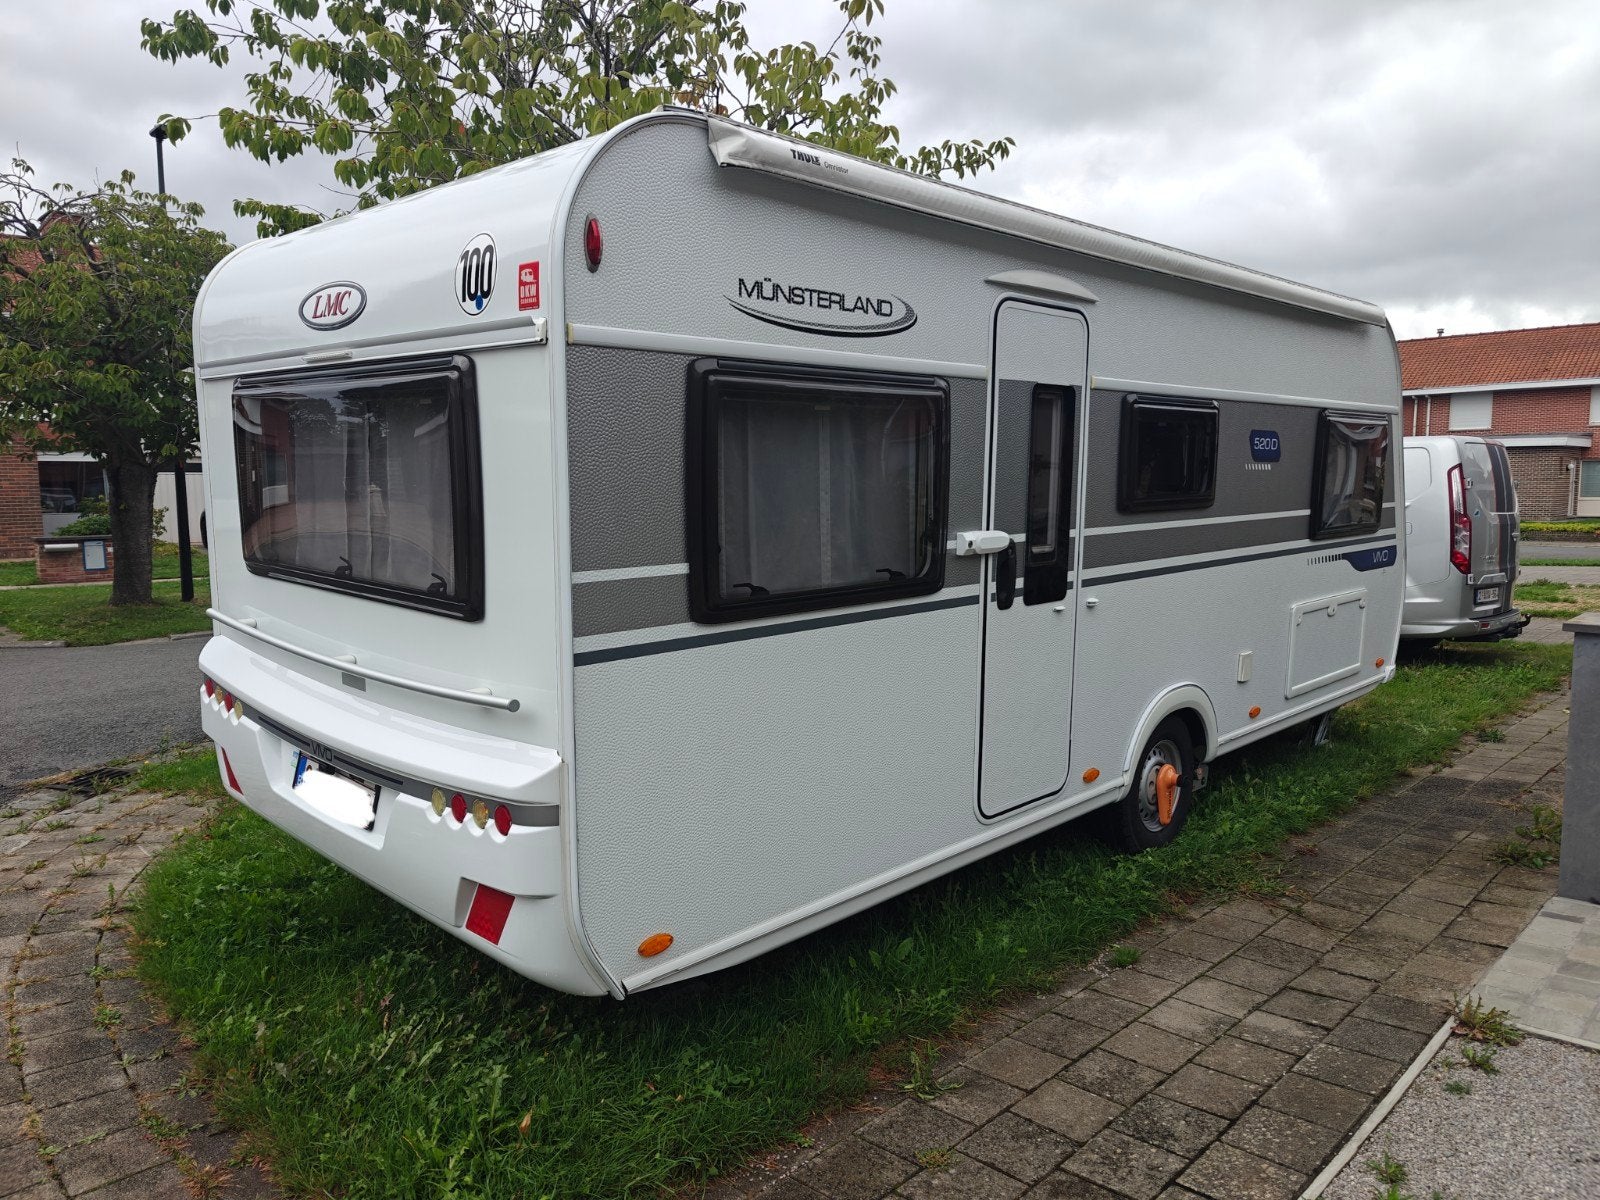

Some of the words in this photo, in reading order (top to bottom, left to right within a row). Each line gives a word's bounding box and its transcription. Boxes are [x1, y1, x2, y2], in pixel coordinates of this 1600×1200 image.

[790, 148, 821, 166] THULE
[460, 244, 494, 302] 100
[312, 290, 351, 319] LMC
[738, 277, 893, 317] MÜNSTERLAND
[1253, 437, 1279, 451] 520D
[1372, 550, 1389, 563] VIVO
[310, 740, 333, 762] VIVO
